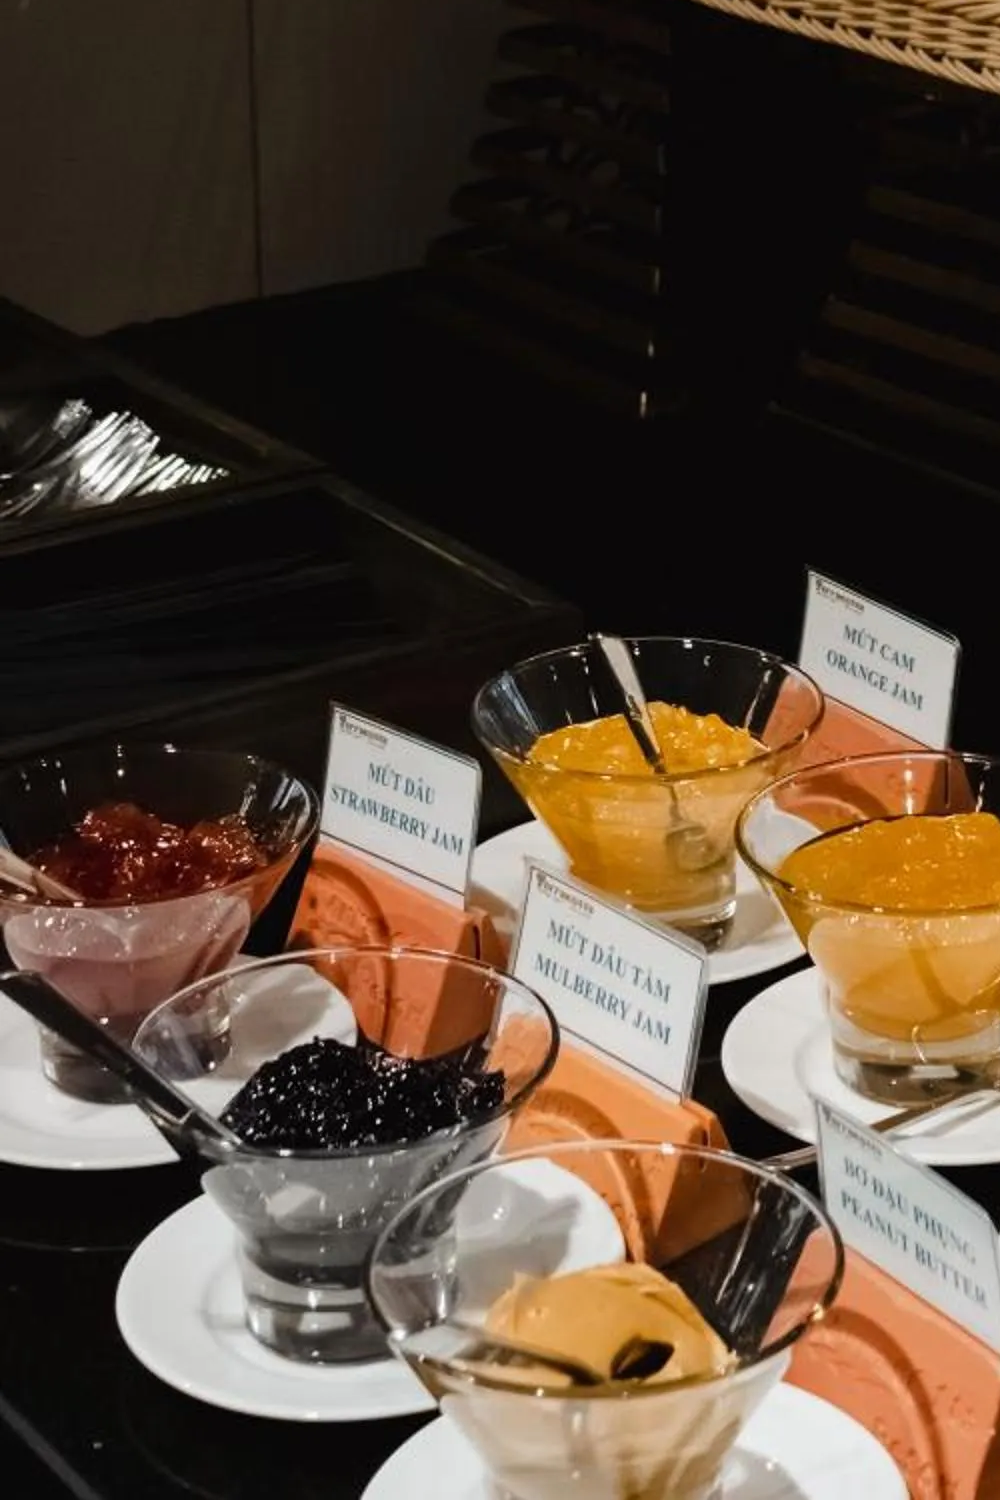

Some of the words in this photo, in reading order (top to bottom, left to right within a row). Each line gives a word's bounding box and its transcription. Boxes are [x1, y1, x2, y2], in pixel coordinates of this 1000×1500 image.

[826, 649, 889, 693] ORANGE
[892, 682, 923, 710] JAM
[880, 643, 916, 673] CAM
[331, 786, 432, 840] STRAWBERRY
[432, 827, 463, 855] JAM
[534, 953, 632, 1021] MULBERRY
[633, 1010, 671, 1045] JAM
[841, 1190, 909, 1252] PEANUT
[915, 1242, 988, 1310] BUTTER
